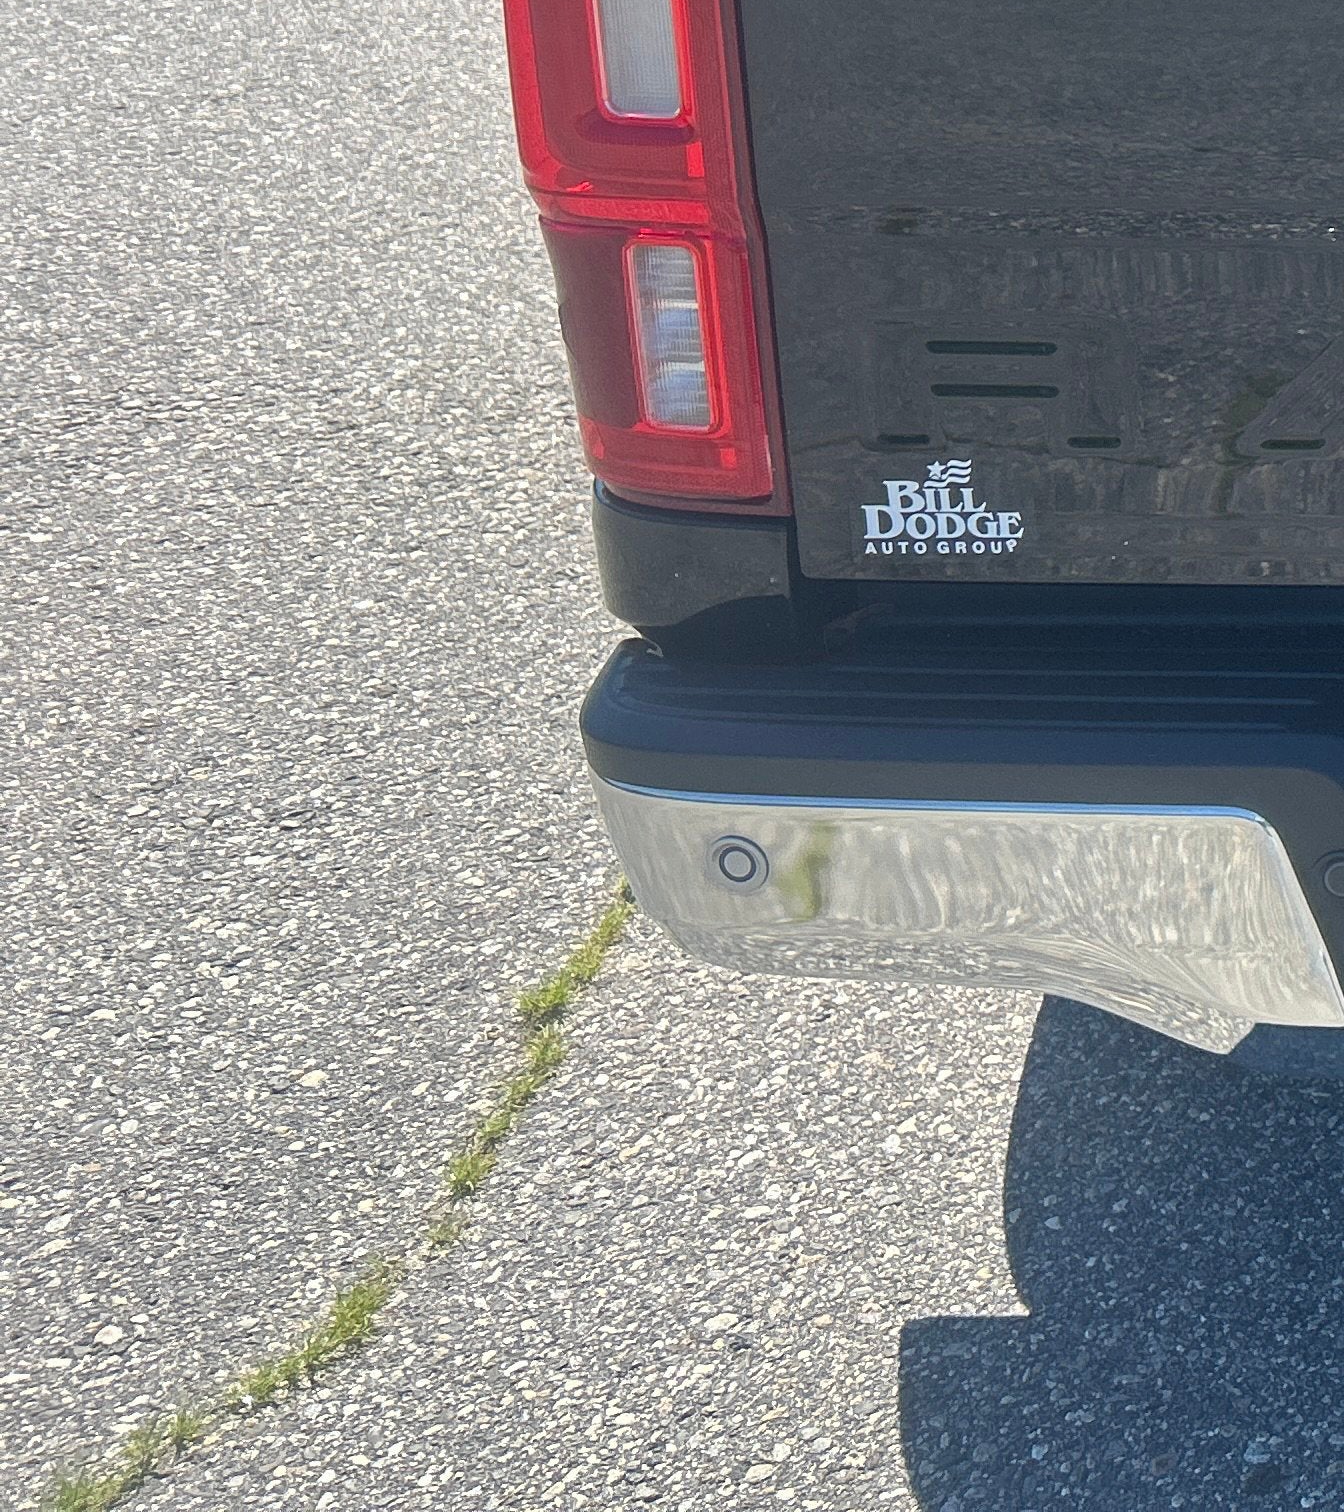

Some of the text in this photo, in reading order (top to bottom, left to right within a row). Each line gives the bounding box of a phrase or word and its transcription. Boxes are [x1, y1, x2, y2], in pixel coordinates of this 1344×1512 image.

[882, 480, 986, 512] BILL
[860, 504, 1025, 539] DODGE
[865, 538, 1018, 555] AUTO GROUP
